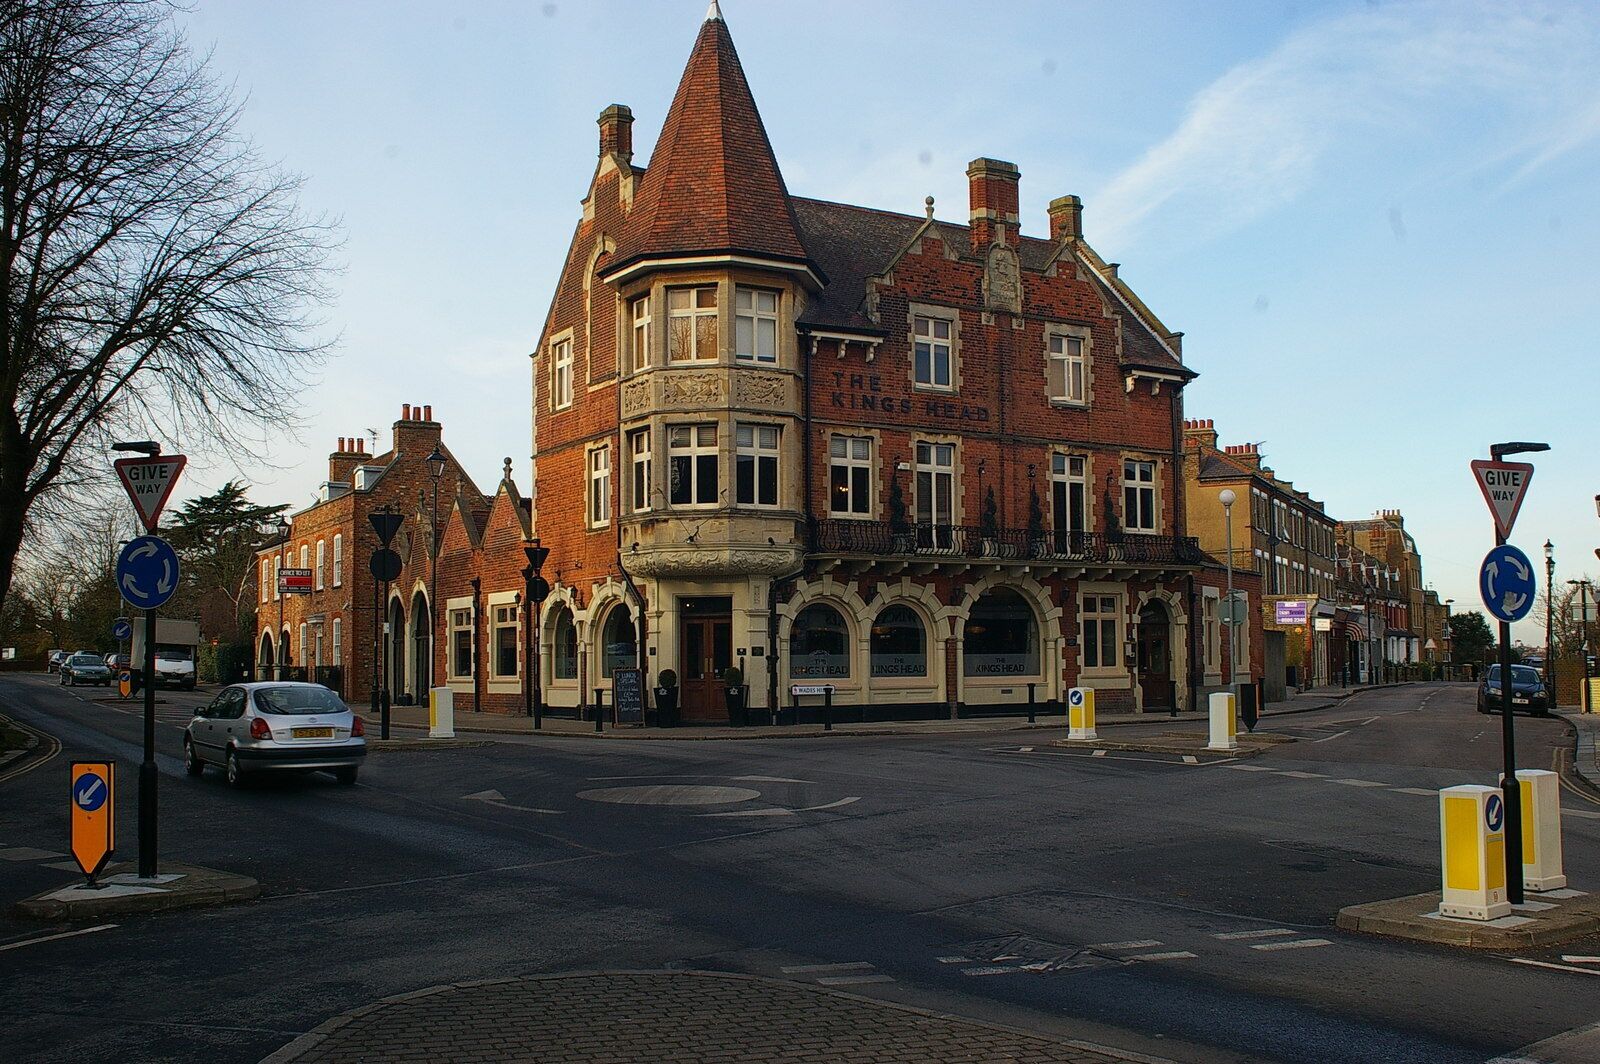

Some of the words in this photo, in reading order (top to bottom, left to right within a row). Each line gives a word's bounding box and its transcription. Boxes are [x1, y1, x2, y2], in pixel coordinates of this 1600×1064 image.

[832, 370, 881, 392] THE
[832, 392, 912, 413] KINGS
[926, 401, 990, 422] HEAD
[129, 464, 168, 480] GIVE
[1485, 470, 1520, 487] GIVE
[136, 483, 161, 494] WAY
[1492, 490, 1515, 501] WAY
[901, 664, 926, 674] HEAD
[975, 664, 1000, 673] KINGS
[1002, 664, 1025, 673] HEAD
